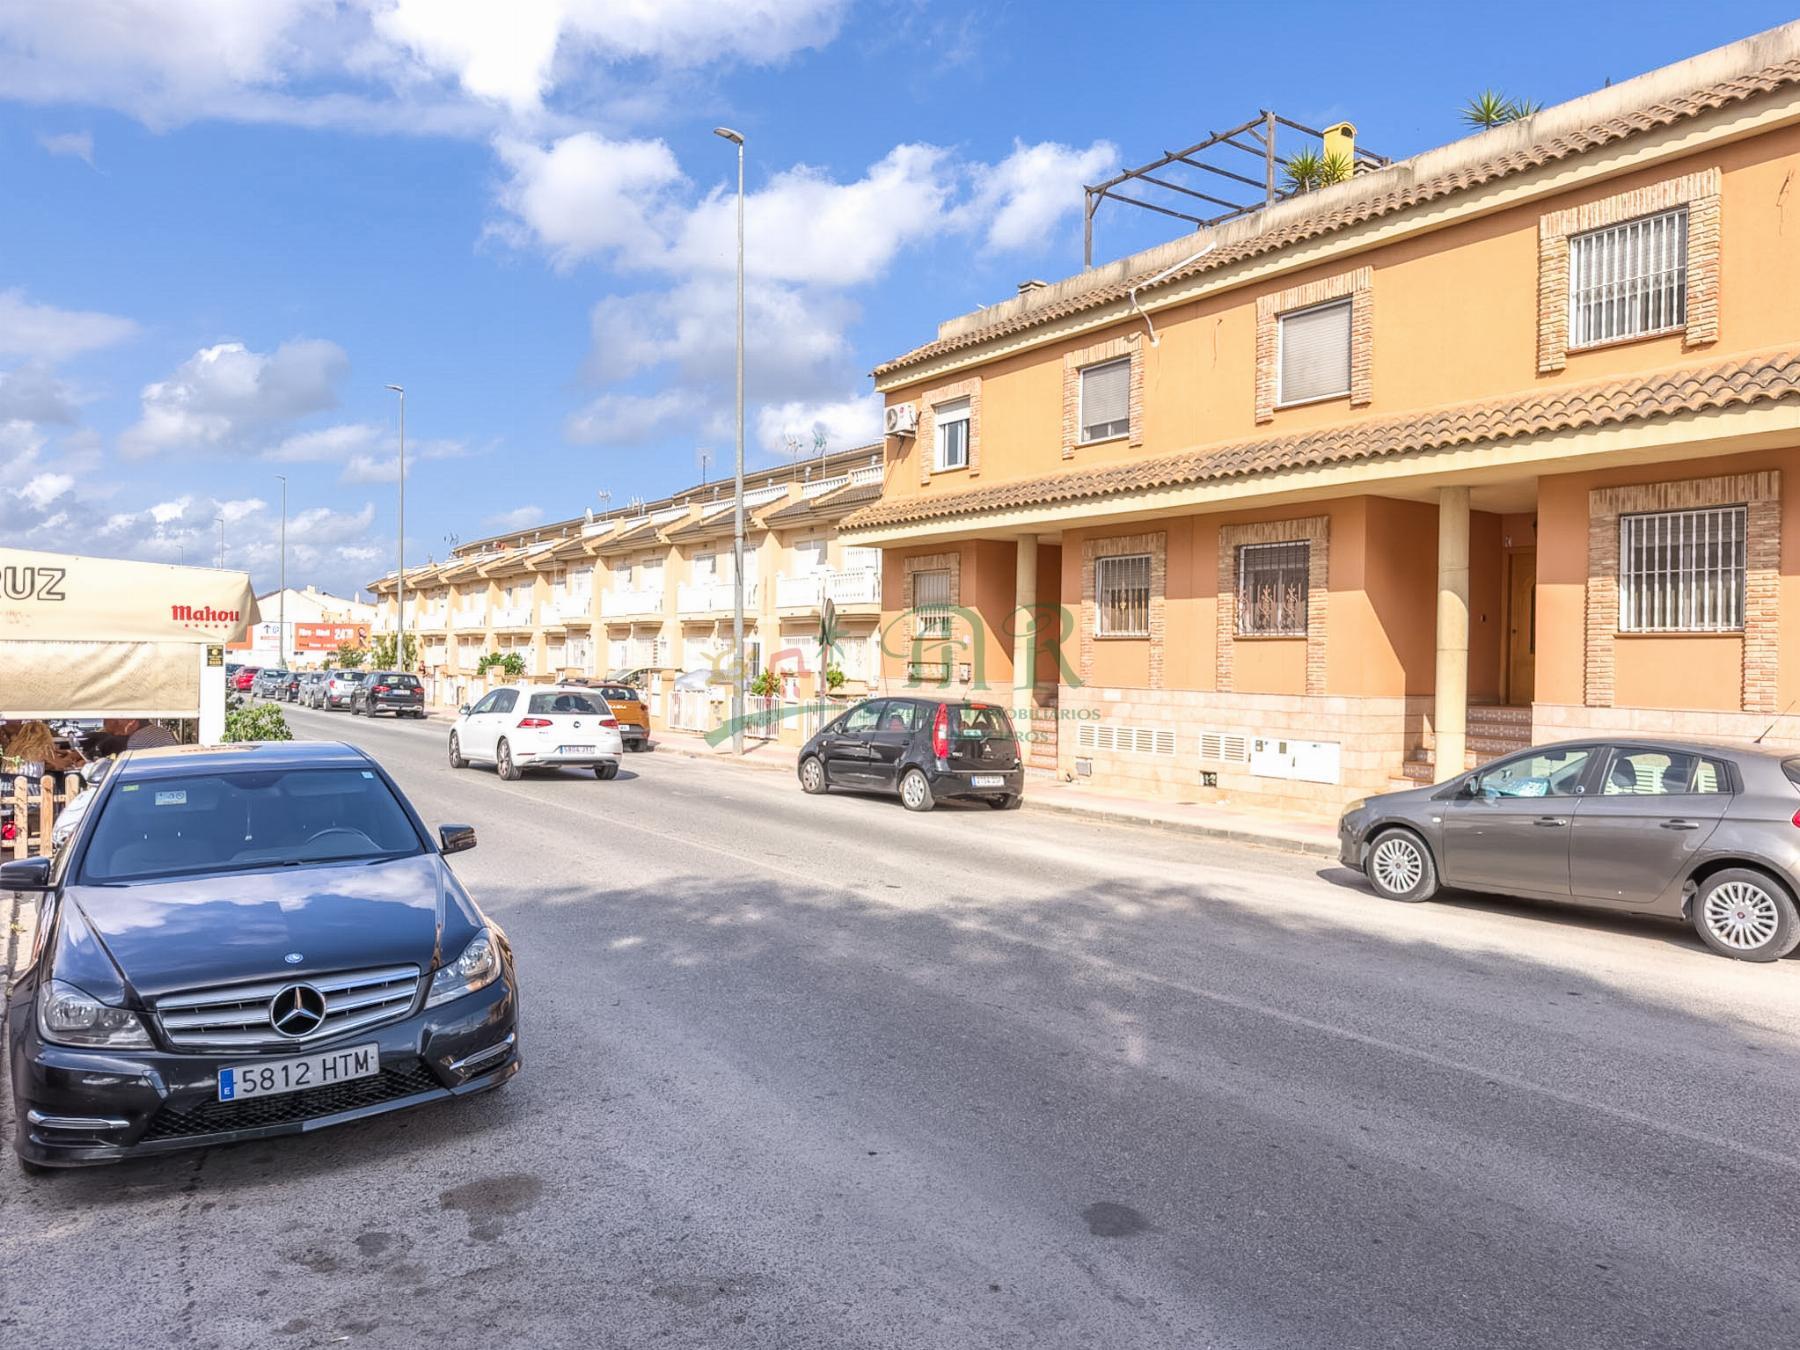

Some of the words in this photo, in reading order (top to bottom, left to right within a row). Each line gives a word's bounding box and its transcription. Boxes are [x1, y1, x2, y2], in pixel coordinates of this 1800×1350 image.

[0, 566, 66, 601] UZ
[171, 604, 240, 622] Mahou
[242, 1062, 311, 1094] 5812
[321, 1049, 370, 1081] HTM
